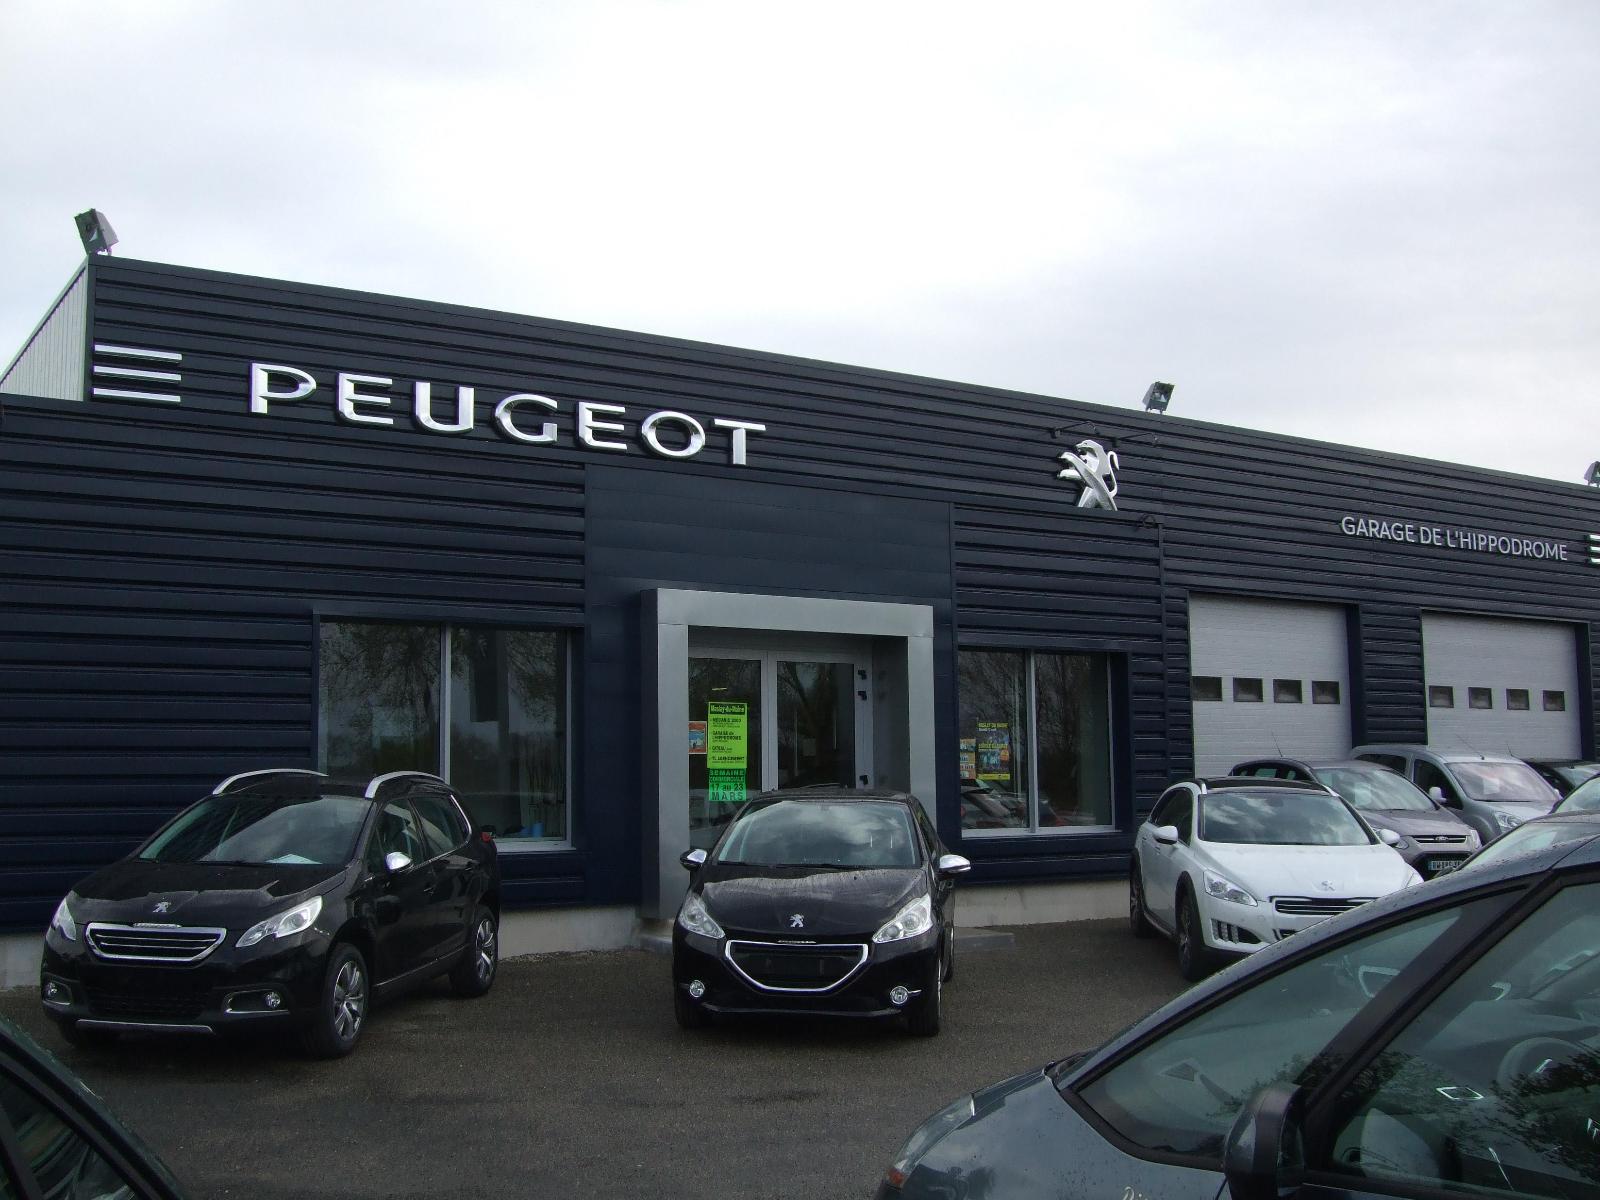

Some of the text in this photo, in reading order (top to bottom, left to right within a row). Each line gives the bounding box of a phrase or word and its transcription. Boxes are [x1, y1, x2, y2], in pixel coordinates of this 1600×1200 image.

[250, 361, 766, 465] PEUGEOT
[1341, 516, 1568, 561] GARAGE DE L'HIPPODROME
[711, 783, 720, 791] 17
[734, 783, 744, 791] 23
[712, 791, 743, 801] MARS
